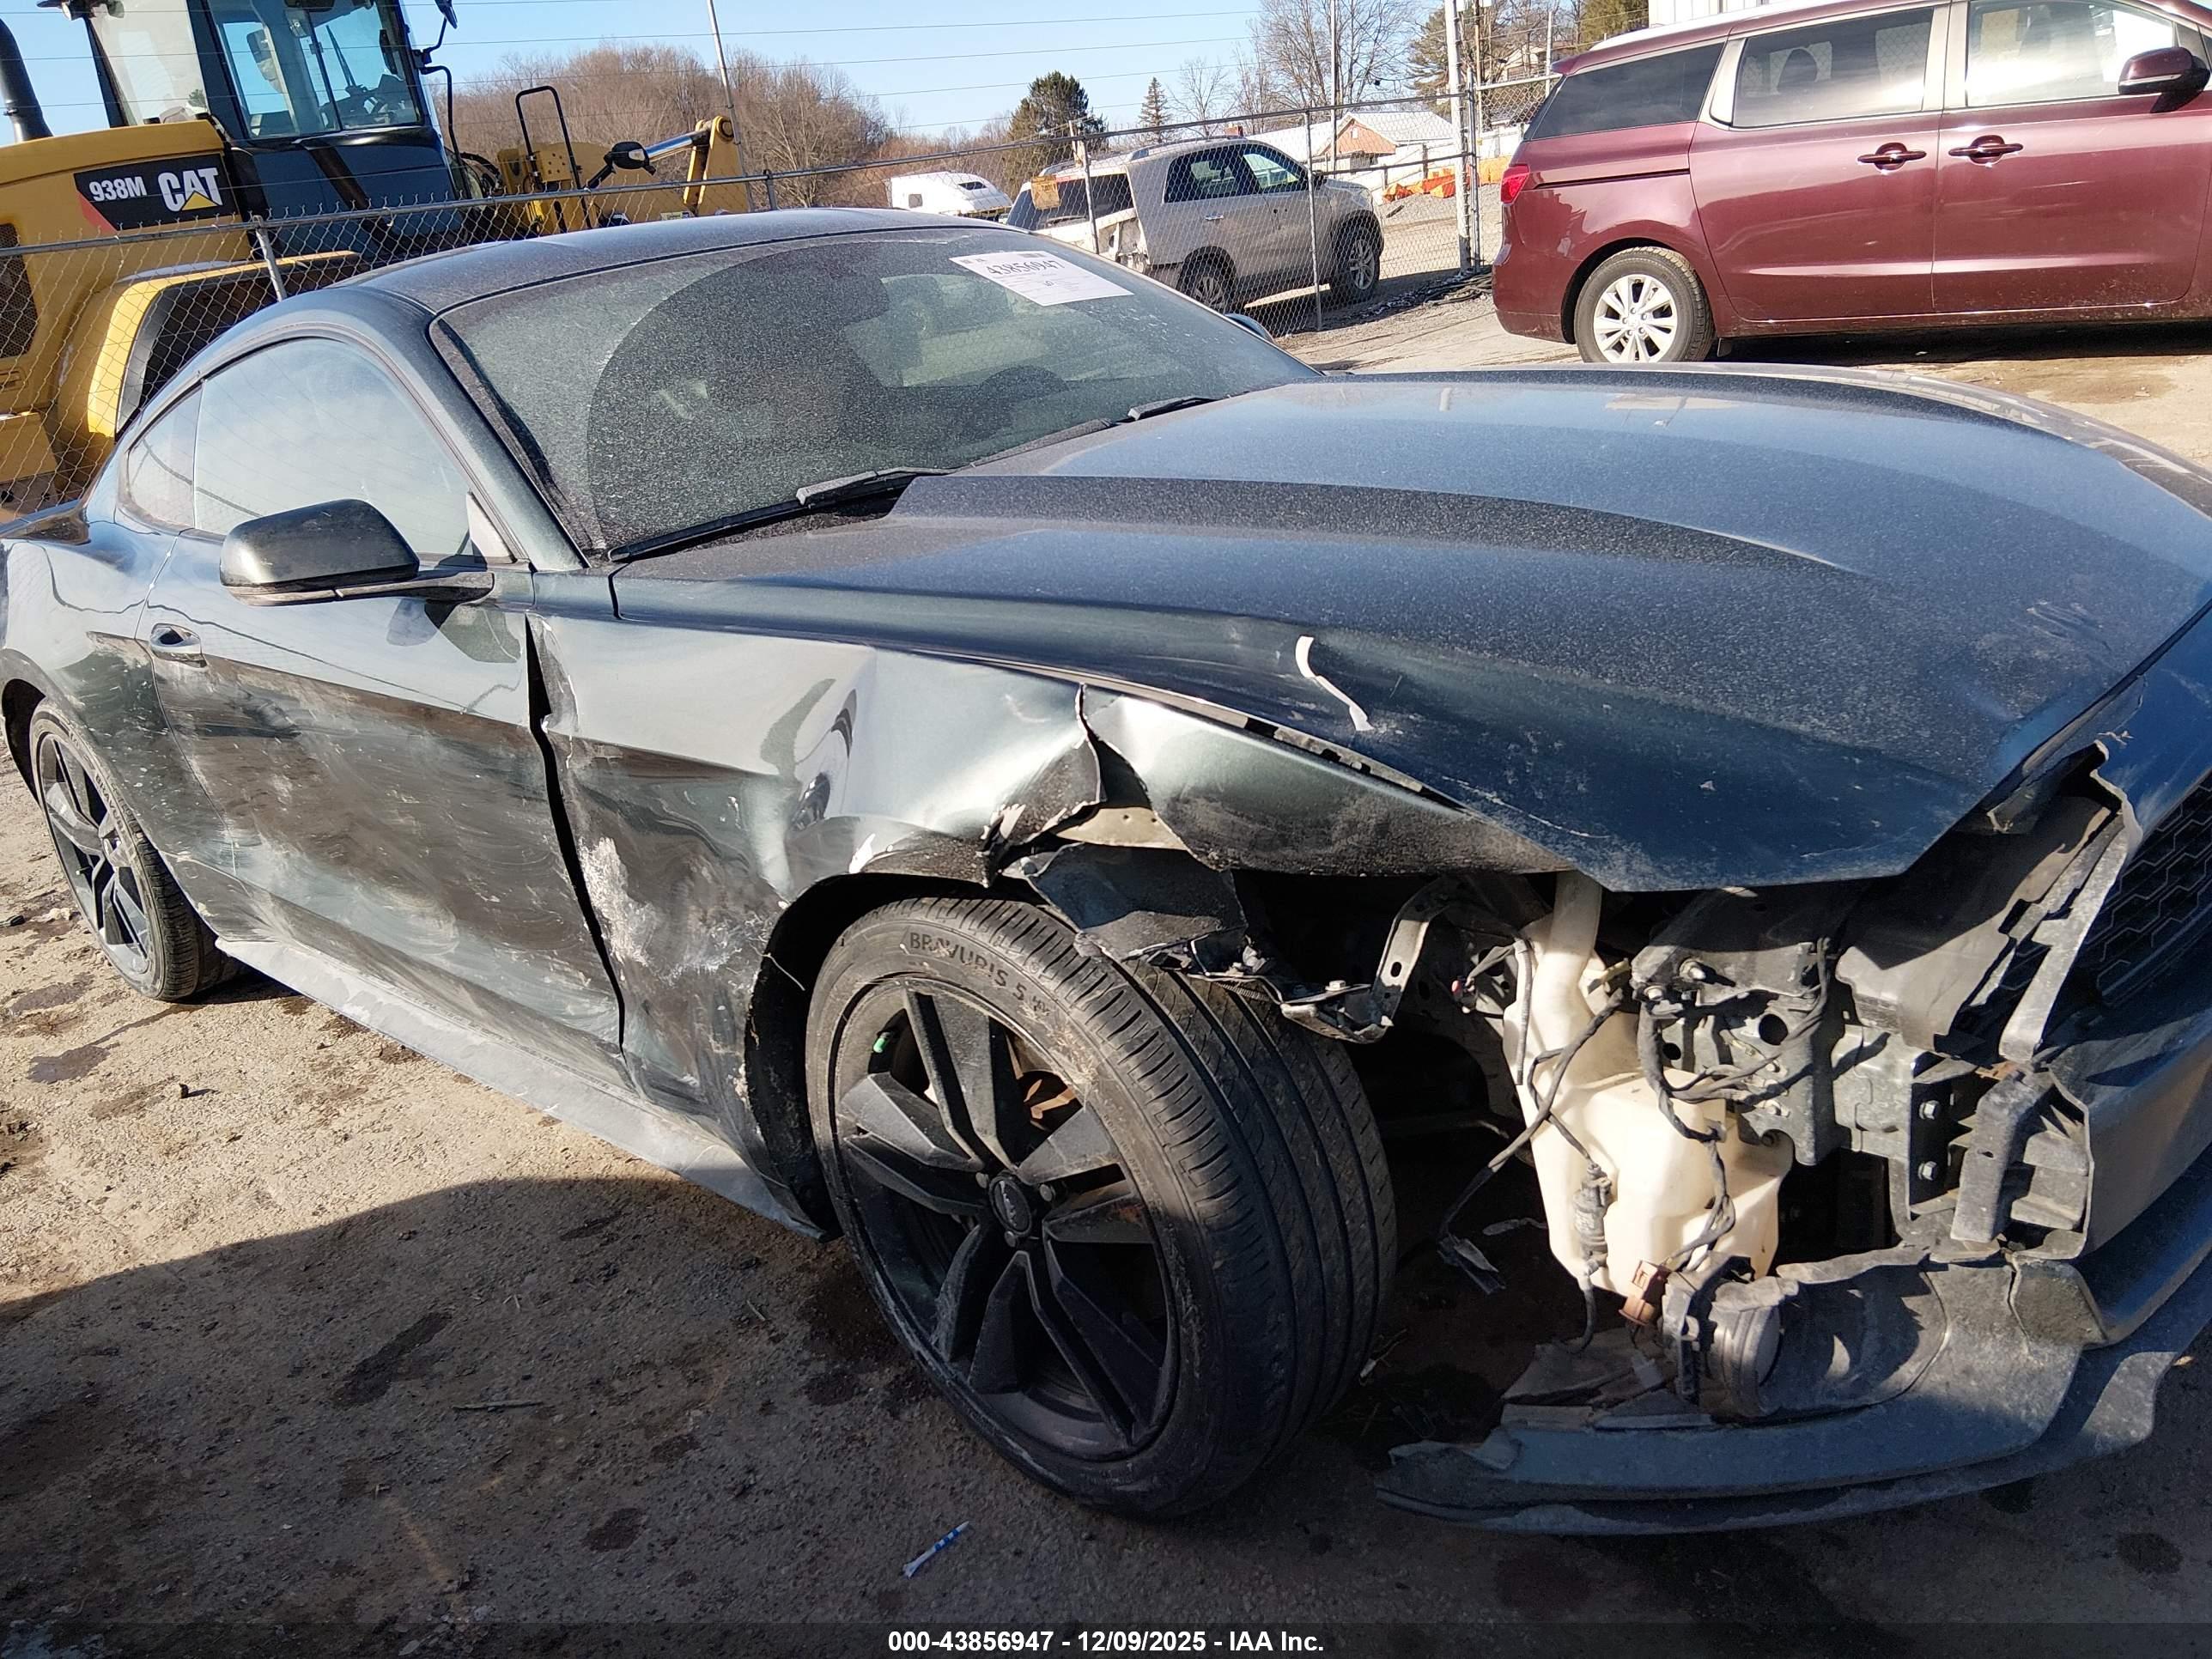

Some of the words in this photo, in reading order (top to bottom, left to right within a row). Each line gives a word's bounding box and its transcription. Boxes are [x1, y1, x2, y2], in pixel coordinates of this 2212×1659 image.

[89, 176, 147, 202] 938M
[158, 167, 223, 211] CAT
[986, 260, 1066, 275] 43856947
[910, 933, 1008, 987] BRAVURIS
